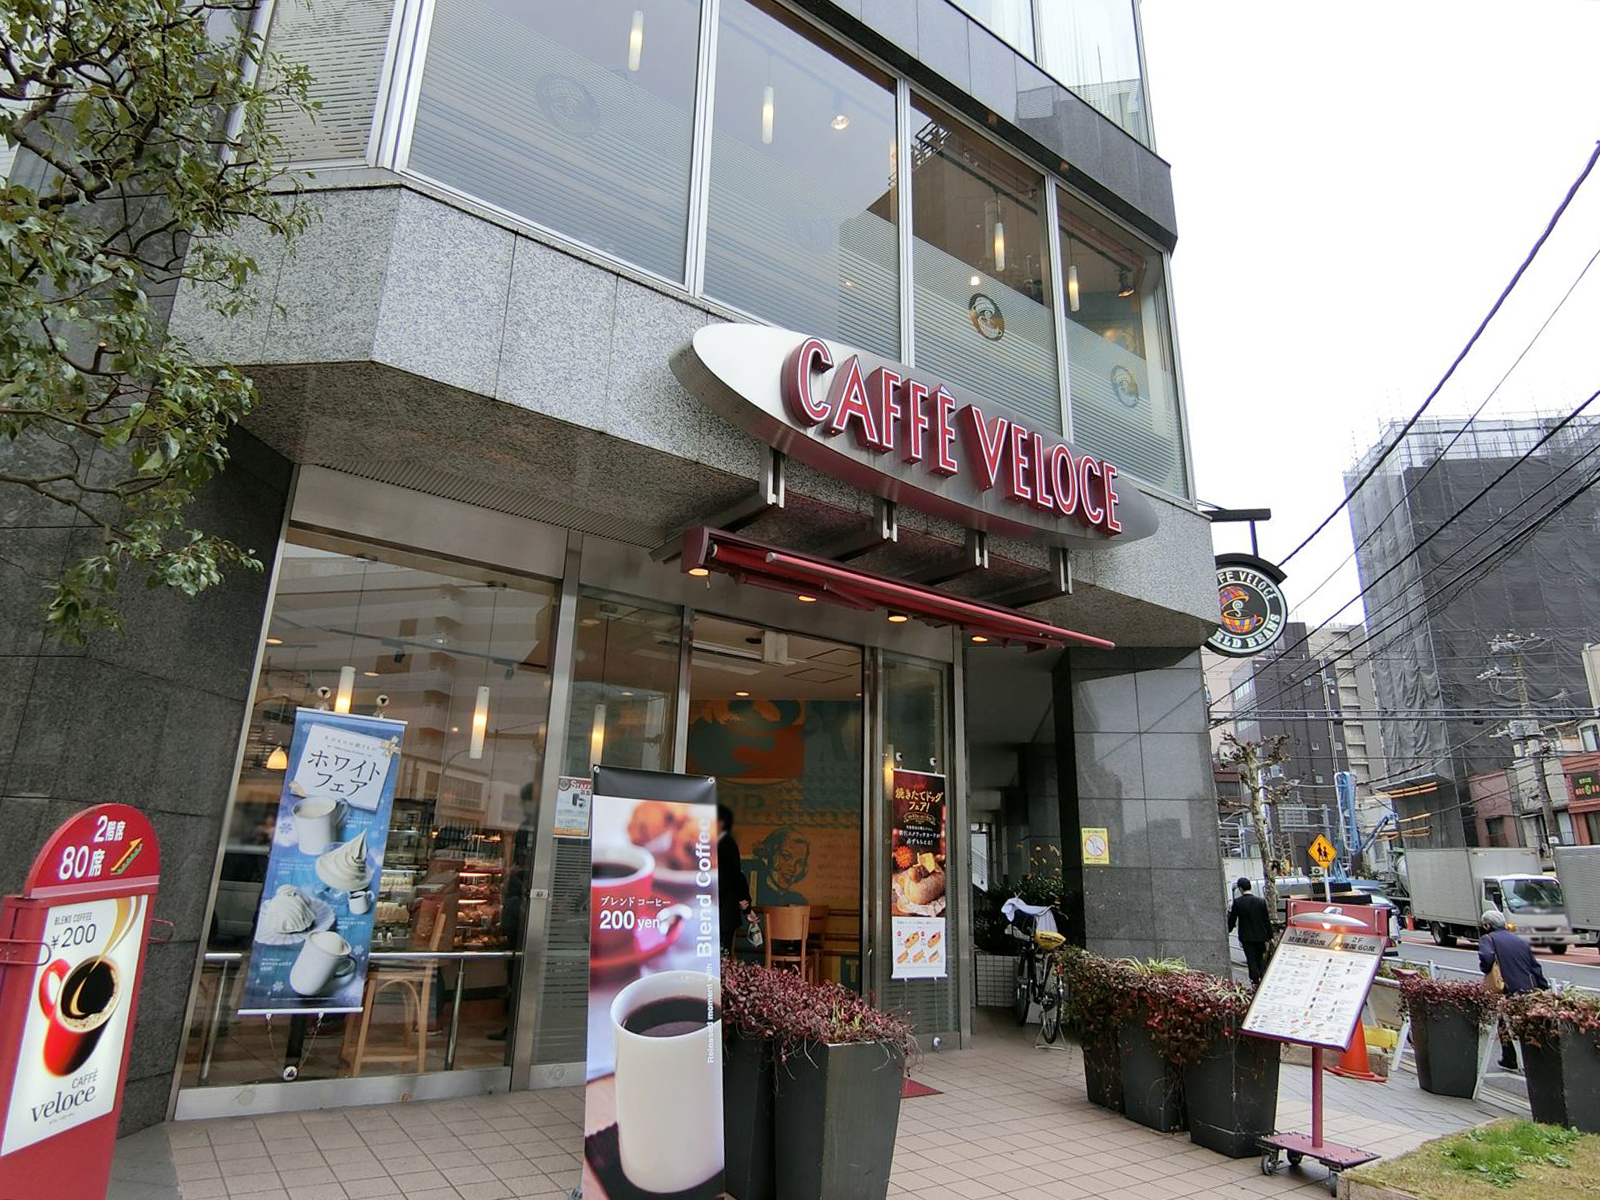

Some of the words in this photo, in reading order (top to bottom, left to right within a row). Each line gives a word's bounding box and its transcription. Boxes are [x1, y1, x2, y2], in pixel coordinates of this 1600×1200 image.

[963, 404, 1122, 535] VELOCE
[1239, 571, 1277, 600] VELOCE
[1212, 630, 1241, 648] RLD
[1246, 613, 1281, 648] BEANS
[307, 750, 381, 782] ホワイト
[314, 772, 369, 797] フェア
[895, 787, 944, 803] 焼きたてドッグ
[93, 815, 126, 843] 2階席
[59, 845, 106, 880] 80席
[695, 819, 712, 888] Coffee
[600, 896, 636, 907] ブレンド
[638, 898, 671, 907] コーヒー
[54, 914, 72, 926] BLEND
[73, 911, 93, 923] COFFEE
[599, 910, 635, 930] 200
[637, 918, 660, 931] yen
[696, 894, 713, 958] Blend
[51, 923, 97, 949] ¥200
[31, 1086, 96, 1122] veloce
